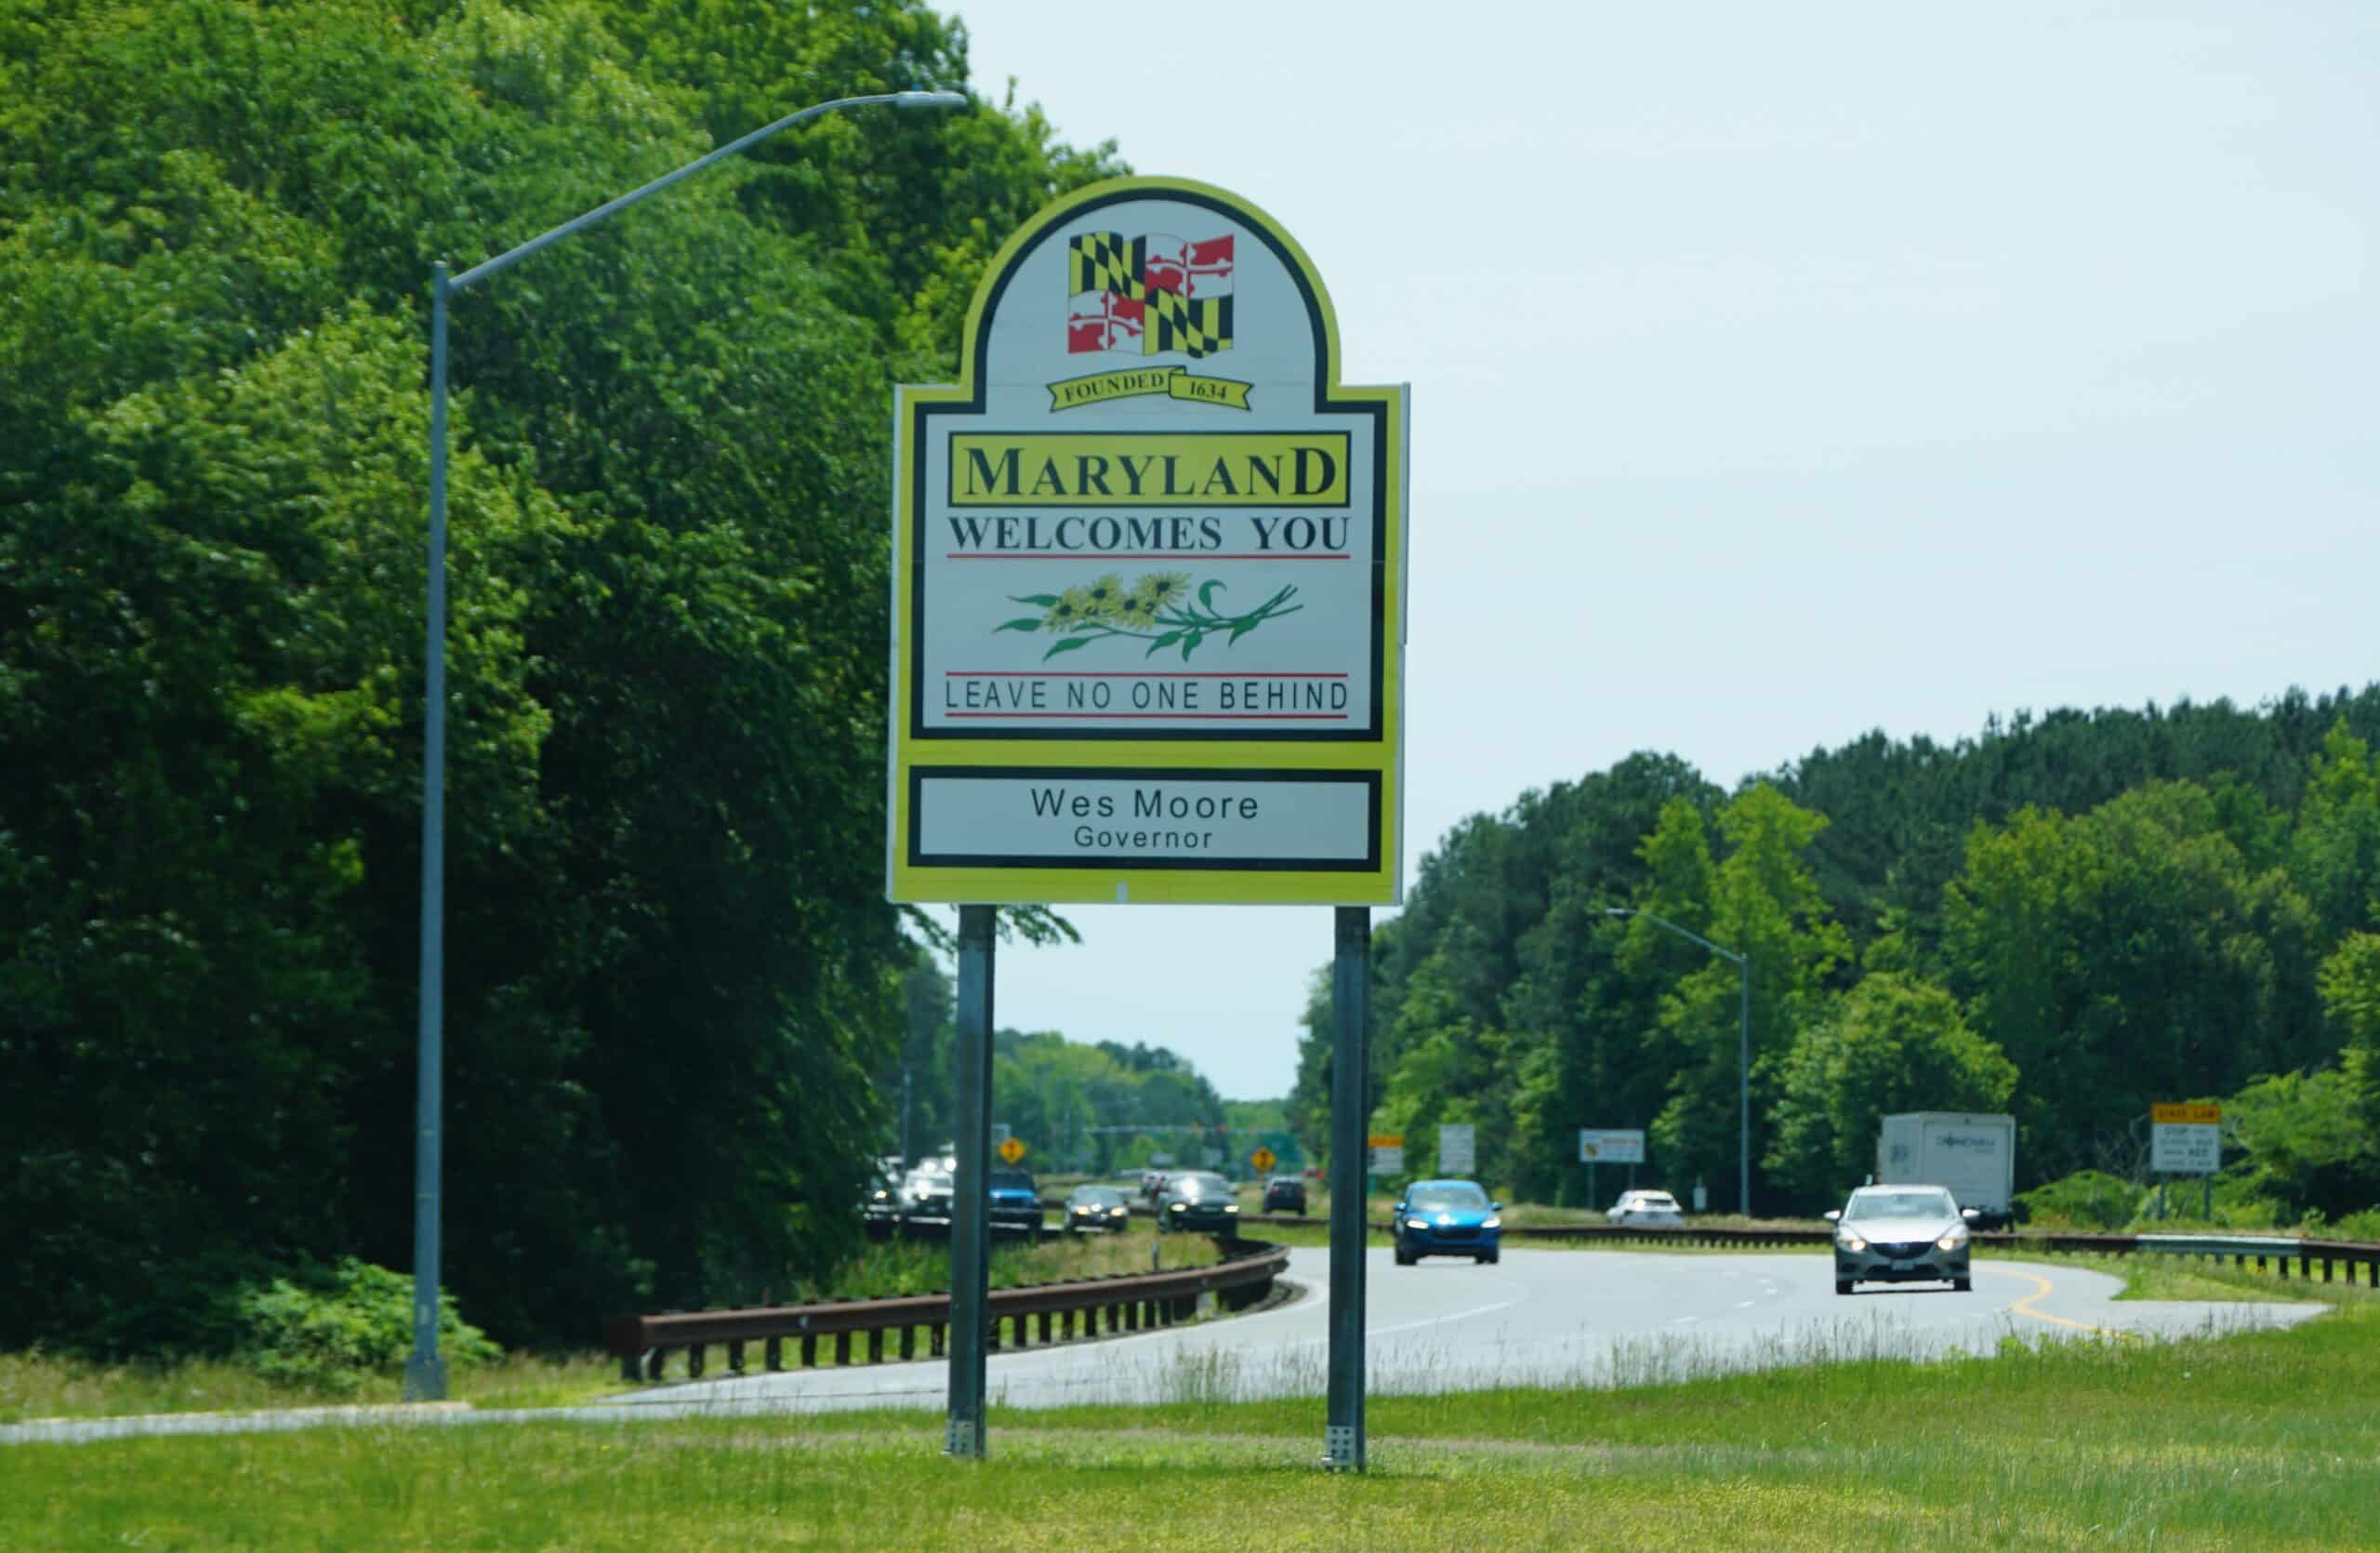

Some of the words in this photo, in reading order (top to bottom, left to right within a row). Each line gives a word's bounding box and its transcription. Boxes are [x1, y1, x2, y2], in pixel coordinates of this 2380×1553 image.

[1064, 371, 1164, 404] FOUNDED
[1188, 379, 1228, 400] 1634
[963, 447, 1336, 496] MARYLAND
[948, 516, 1223, 551] WELCOMES
[1250, 517, 1348, 550] YOU
[945, 681, 1047, 709] LEAVE
[1068, 682, 1112, 709] NO
[1131, 682, 1198, 710] ONE
[1220, 683, 1348, 710] BEHIND
[1031, 788, 1116, 817] Wes
[1133, 790, 1260, 819] Moore
[1073, 826, 1212, 849] Governor
